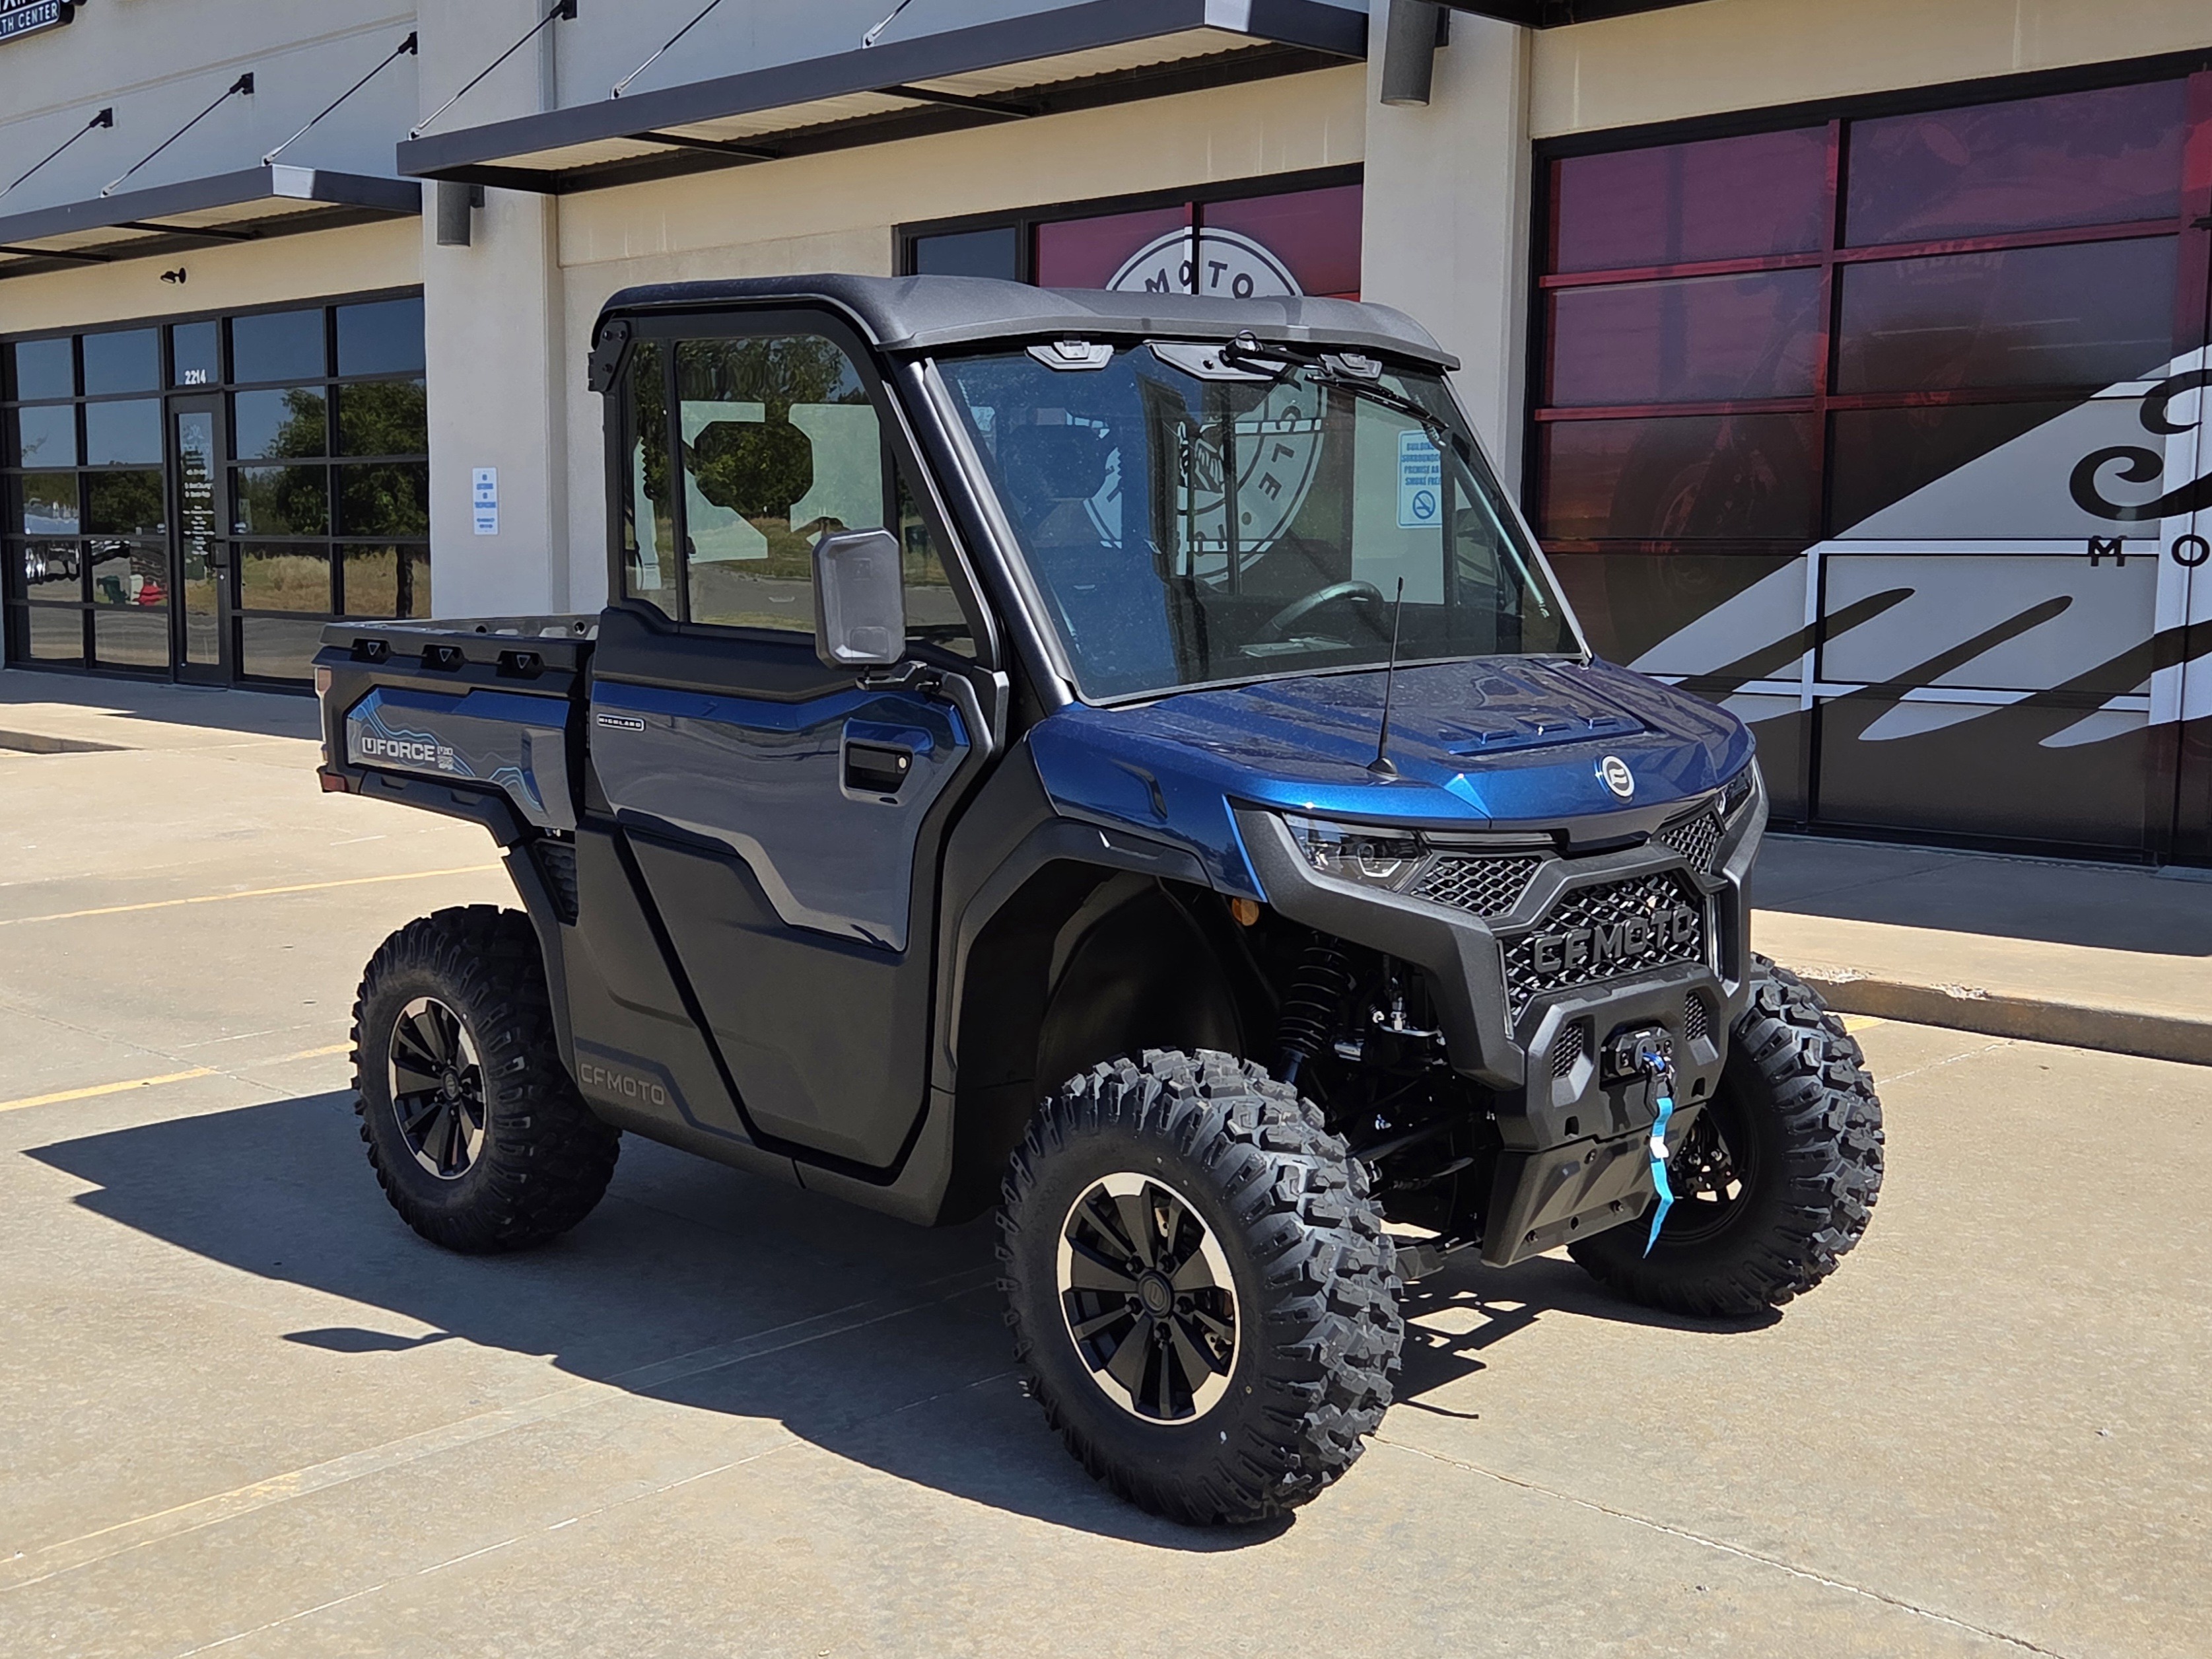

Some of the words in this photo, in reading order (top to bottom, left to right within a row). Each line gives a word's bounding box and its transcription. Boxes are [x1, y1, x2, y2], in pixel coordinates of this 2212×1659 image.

[0, 17, 14, 34] TH
[18, 2, 58, 28] CENTER
[185, 369, 206, 385] 2214
[598, 717, 641, 728] HIGHLAND
[362, 736, 436, 762] UFORCE
[1534, 904, 1693, 974] CFMOTO
[580, 1063, 665, 1106] CFMOTO
